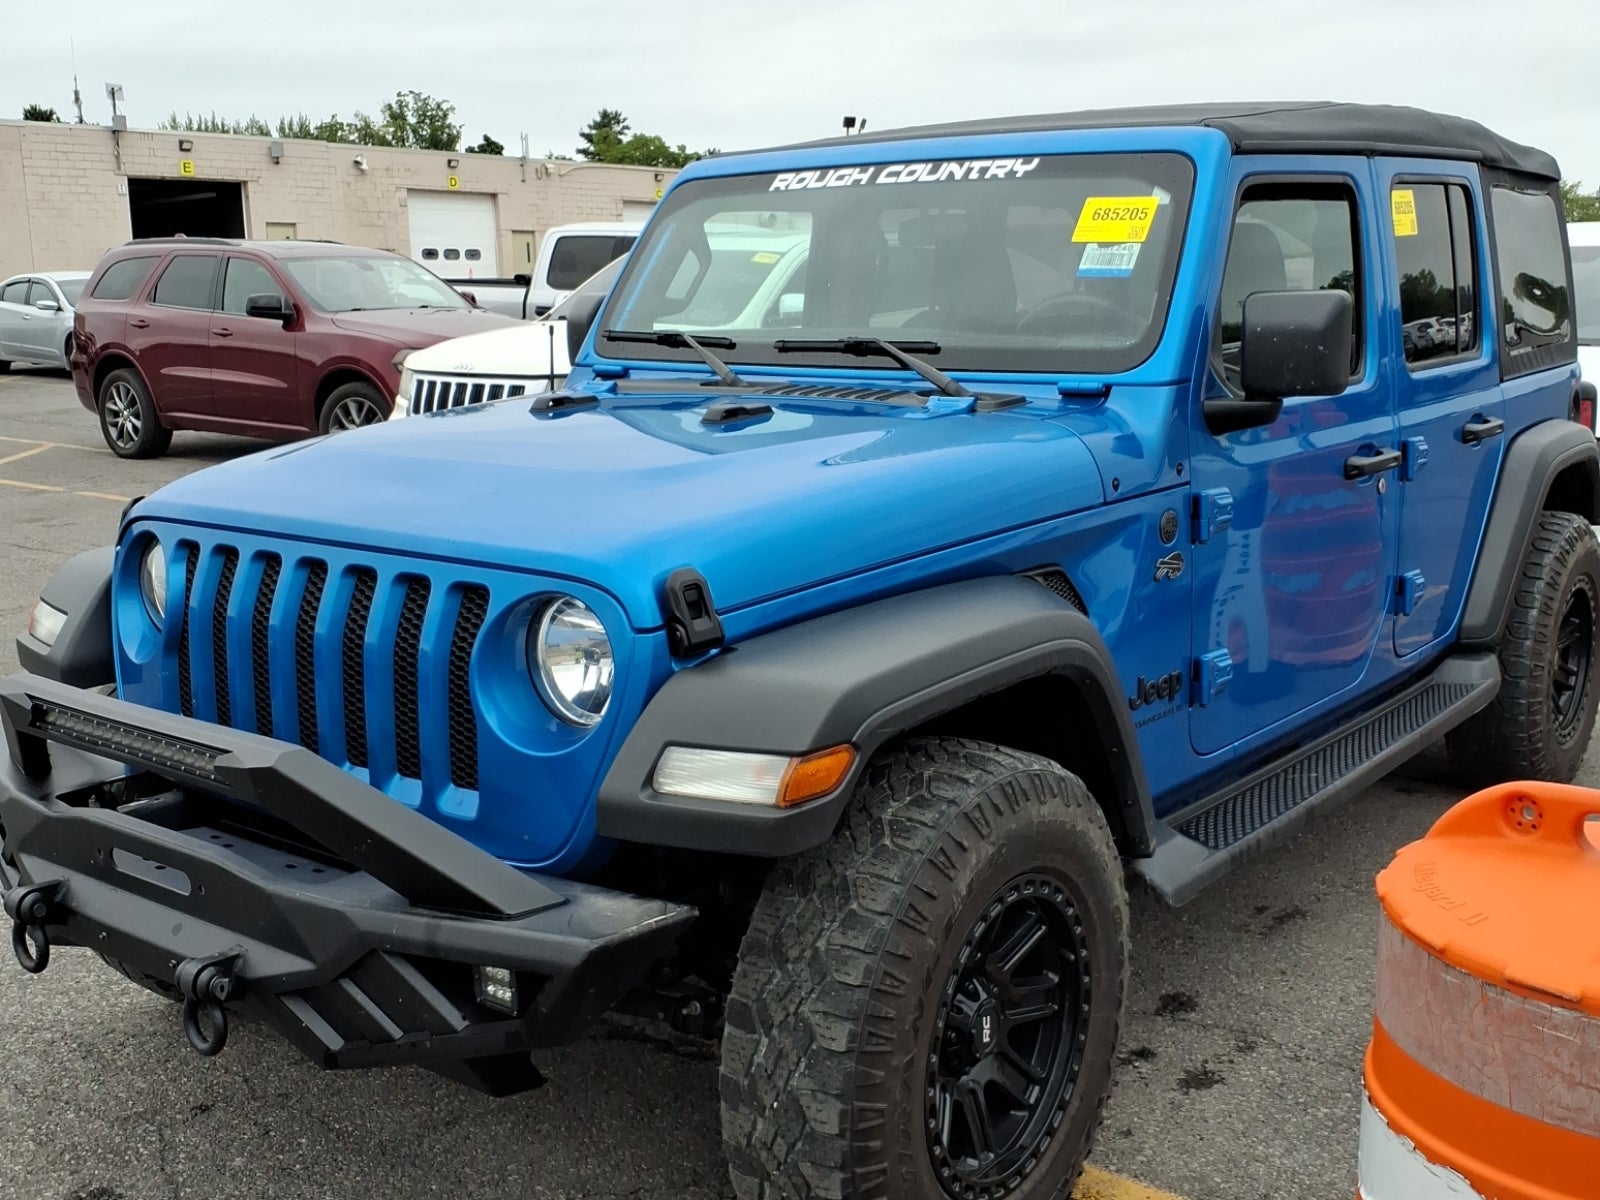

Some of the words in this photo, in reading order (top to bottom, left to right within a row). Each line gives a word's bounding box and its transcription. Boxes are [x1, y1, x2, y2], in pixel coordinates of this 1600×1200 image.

[183, 162, 192, 173] E
[768, 167, 871, 192] ROUGH
[876, 157, 1041, 185] COUNTRY
[449, 177, 457, 187] D
[1091, 207, 1150, 221] 685205
[1129, 670, 1182, 711] Jeep
[982, 1015, 991, 1043] RC
